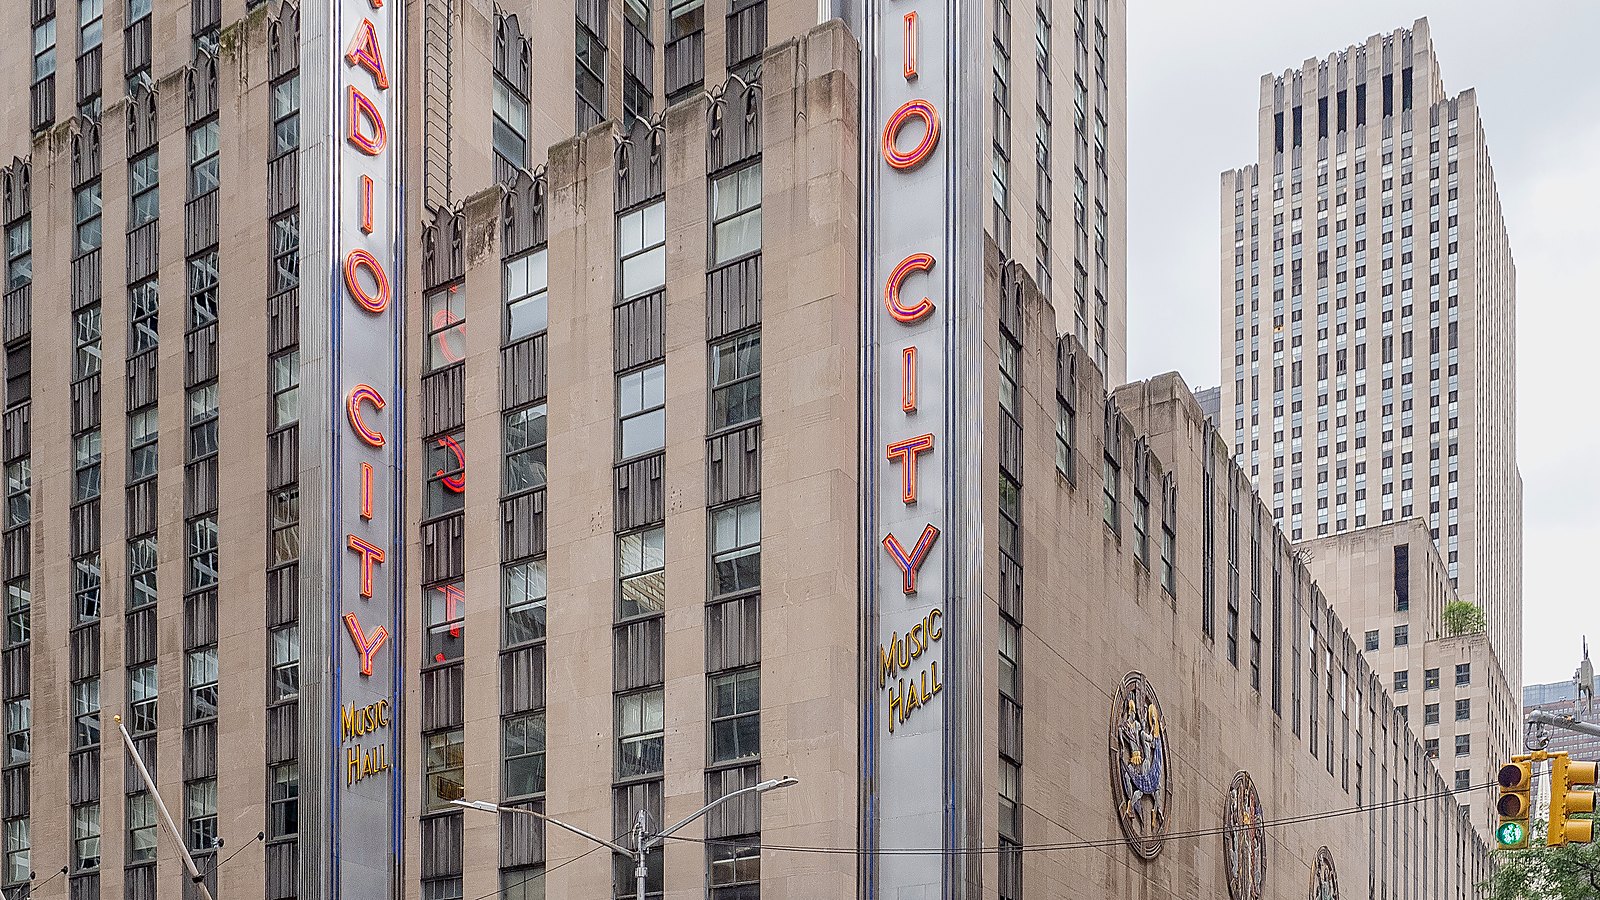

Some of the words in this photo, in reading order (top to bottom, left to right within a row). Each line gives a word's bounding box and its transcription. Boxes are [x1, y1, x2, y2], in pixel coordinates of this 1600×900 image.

[344, 0, 391, 313] ADIO
[881, 252, 941, 595] CITY
[341, 383, 389, 676] CITY
[880, 608, 942, 689] MUSIC
[341, 699, 388, 743] MUSIC
[888, 661, 942, 733] HALL
[347, 744, 388, 786] HALL
